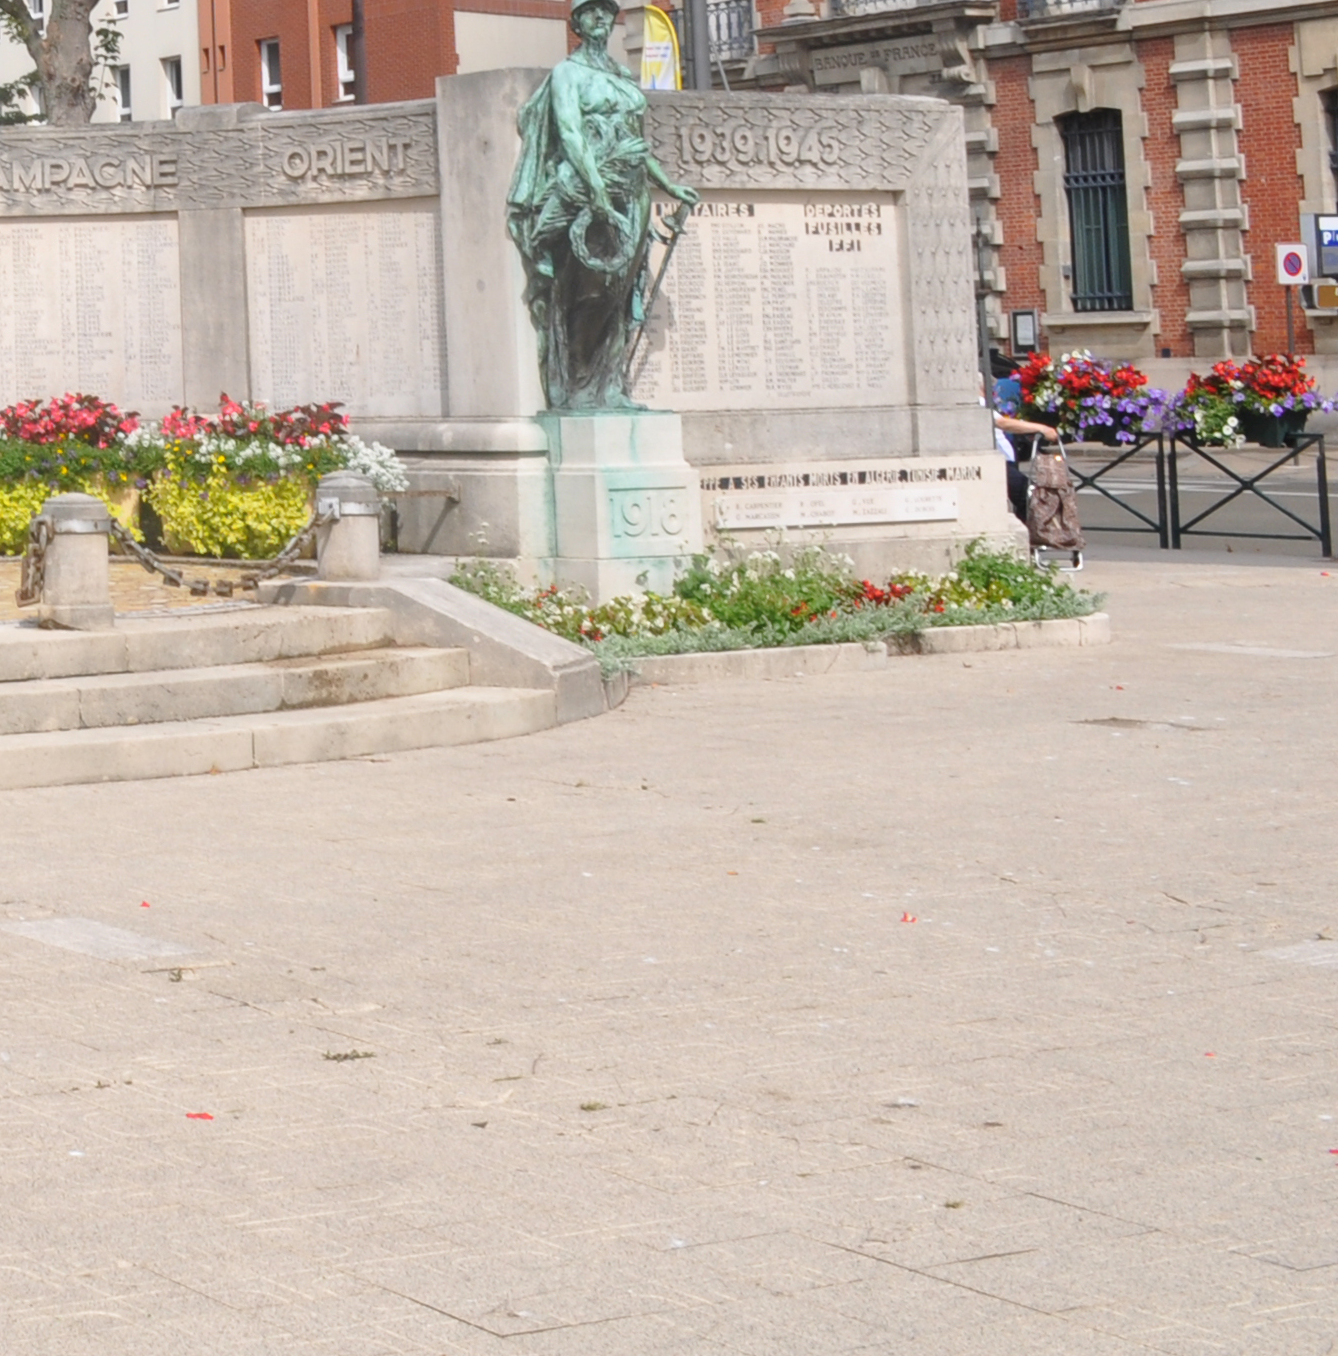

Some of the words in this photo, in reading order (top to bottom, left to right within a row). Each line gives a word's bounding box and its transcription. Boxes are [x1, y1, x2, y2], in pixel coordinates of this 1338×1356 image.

[814, 52, 867, 71] BANQUE
[884, 43, 937, 62] FRANCE
[281, 141, 411, 181] ORIENT
[742, 476, 760, 489] SES
[764, 474, 804, 488] ENFANTS
[809, 473, 841, 487] MORTS
[609, 492, 683, 537] 1918
